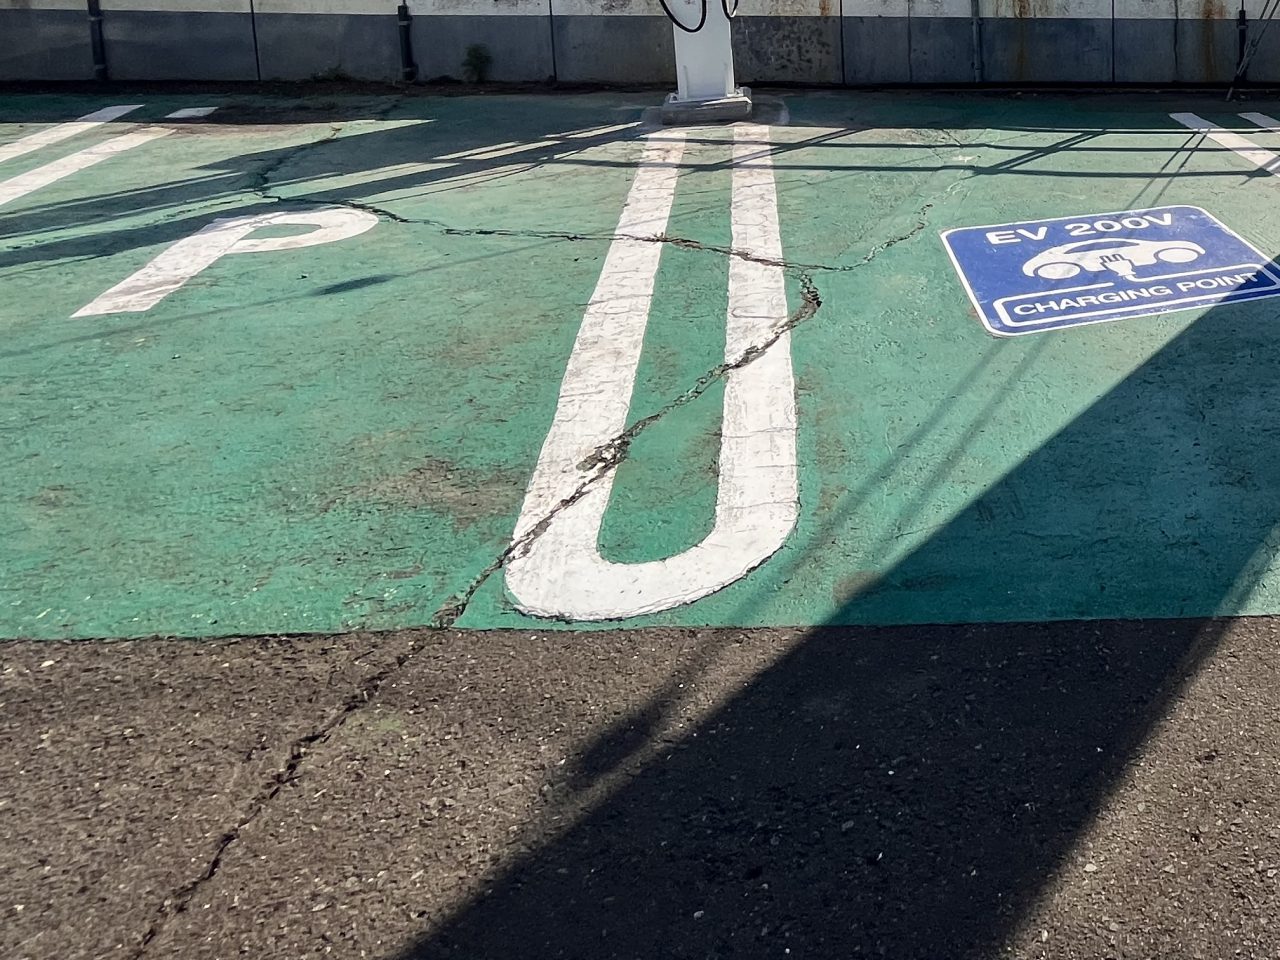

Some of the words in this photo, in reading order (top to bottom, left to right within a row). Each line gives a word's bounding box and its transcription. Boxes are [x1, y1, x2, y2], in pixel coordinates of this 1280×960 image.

[986, 227, 1047, 245] EV
[1065, 213, 1173, 237] 200V
[70, 207, 379, 318] P
[1014, 285, 1172, 316] CHARGING
[1177, 271, 1260, 294] POINT
